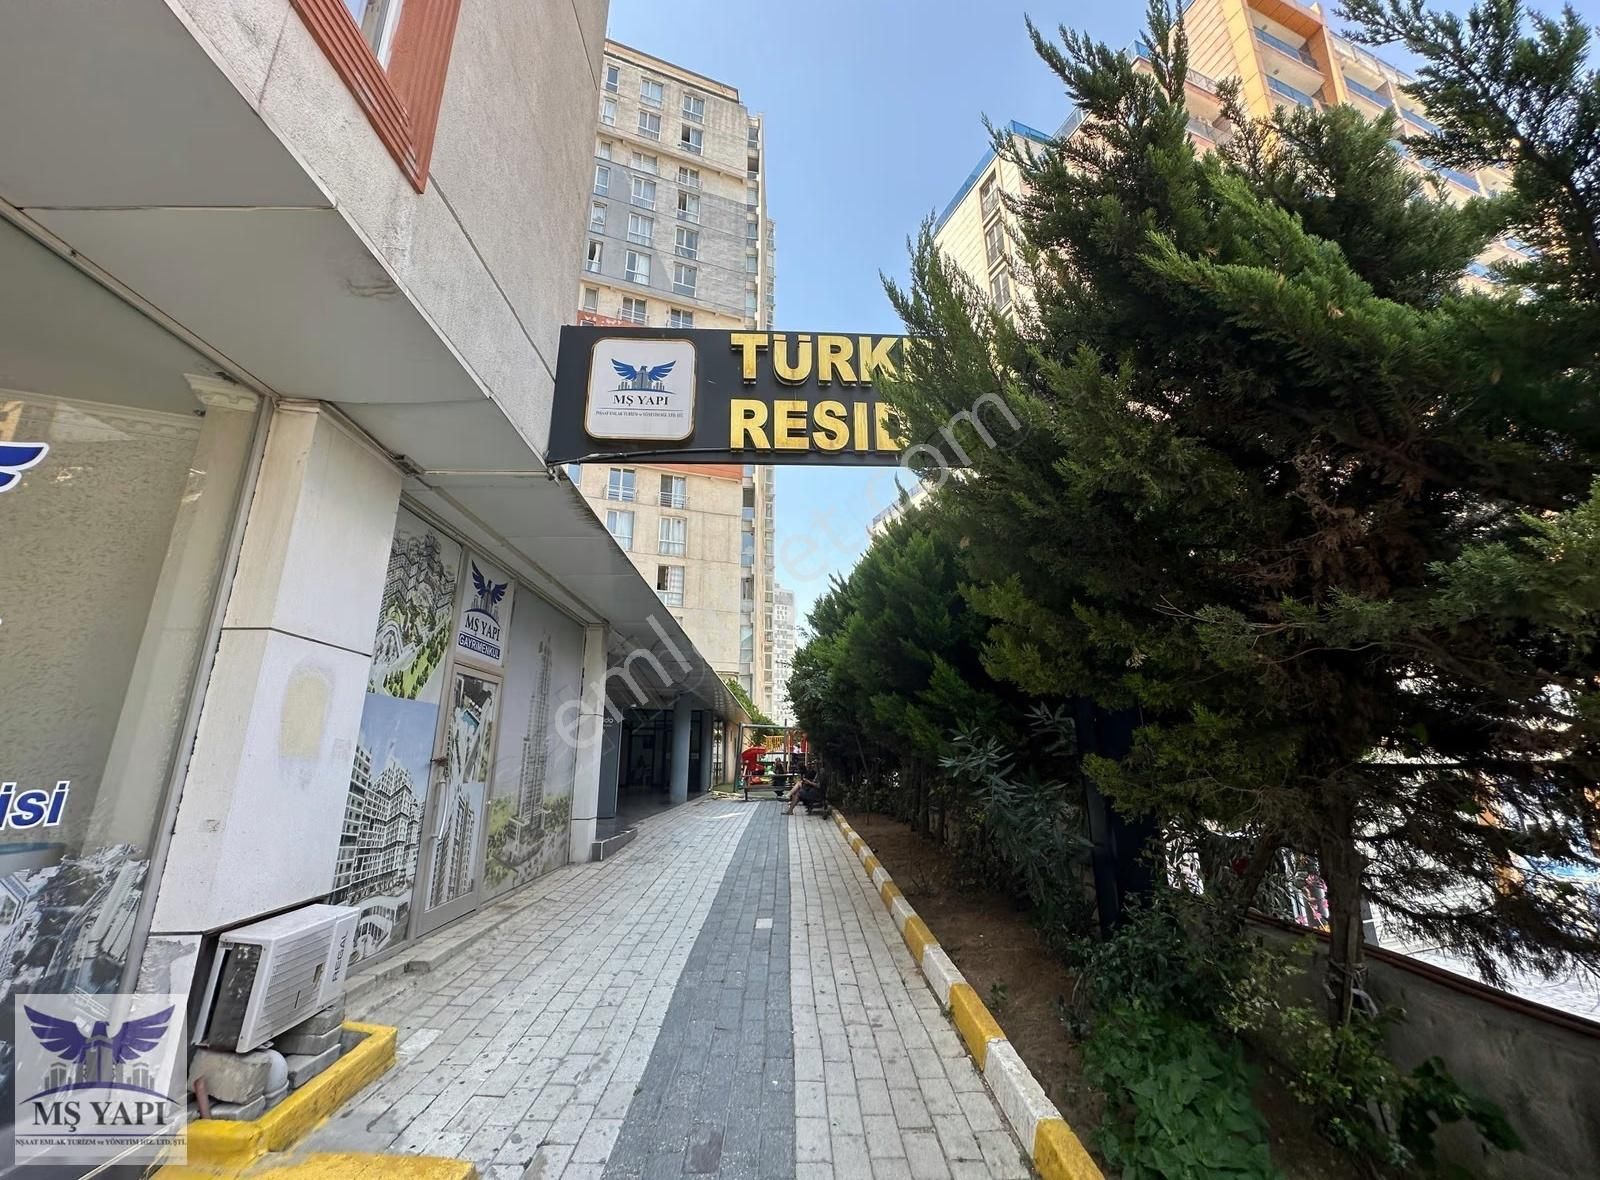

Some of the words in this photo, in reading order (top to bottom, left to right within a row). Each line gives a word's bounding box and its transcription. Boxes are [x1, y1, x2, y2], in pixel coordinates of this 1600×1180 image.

[613, 394, 634, 407] MŞ
[638, 395, 669, 406] YAPI
[465, 614, 479, 636] MŞ
[482, 621, 500, 641] YAPI
